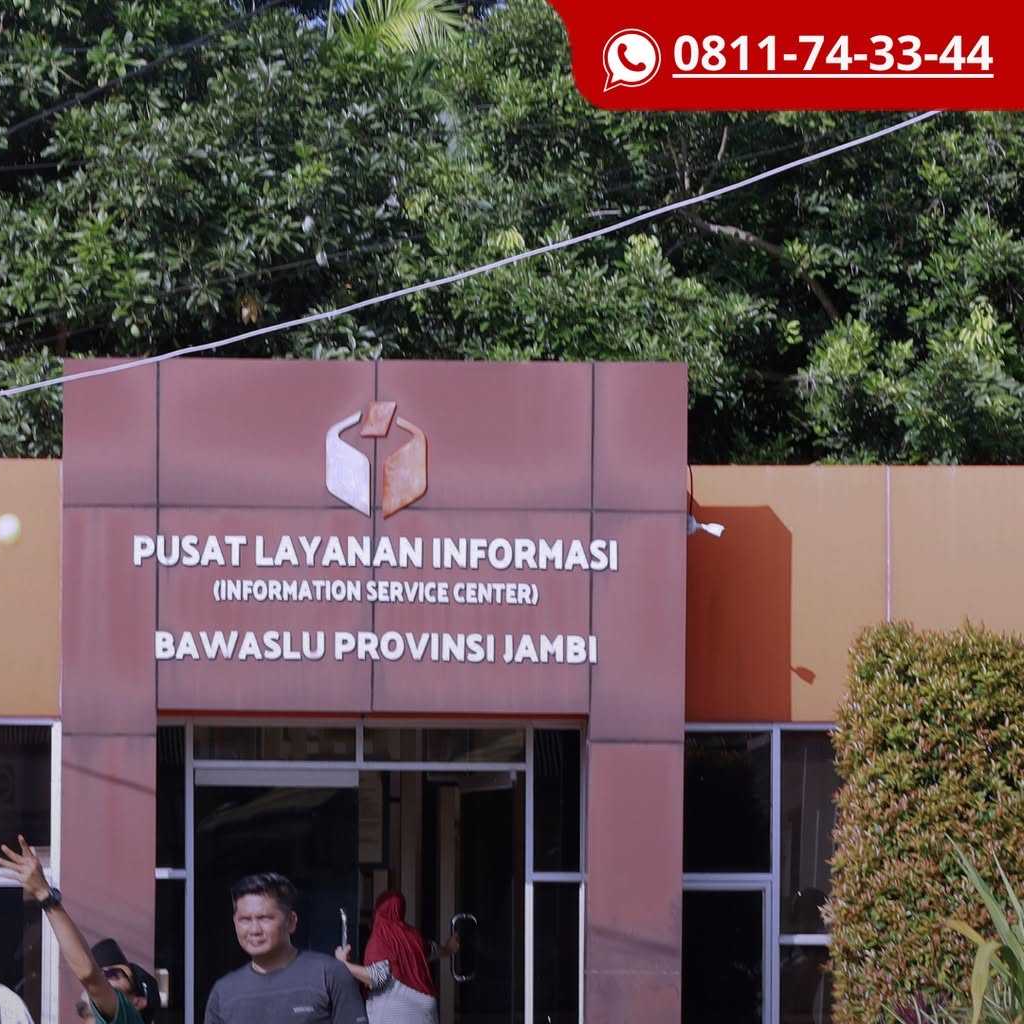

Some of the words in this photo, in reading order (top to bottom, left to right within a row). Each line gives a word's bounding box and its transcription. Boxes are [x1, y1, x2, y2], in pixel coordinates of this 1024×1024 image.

[133, 535, 247, 566] PUSAT
[255, 535, 423, 568] LAYANAN
[432, 537, 618, 571] INFORMASI
[213, 579, 361, 601] (INFORMATION
[366, 580, 449, 603] SERVICE
[453, 582, 539, 605] CENTER)
[155, 630, 325, 660] BAWASLU
[334, 630, 495, 662] PROVINSI
[502, 634, 597, 663] JAMBI
